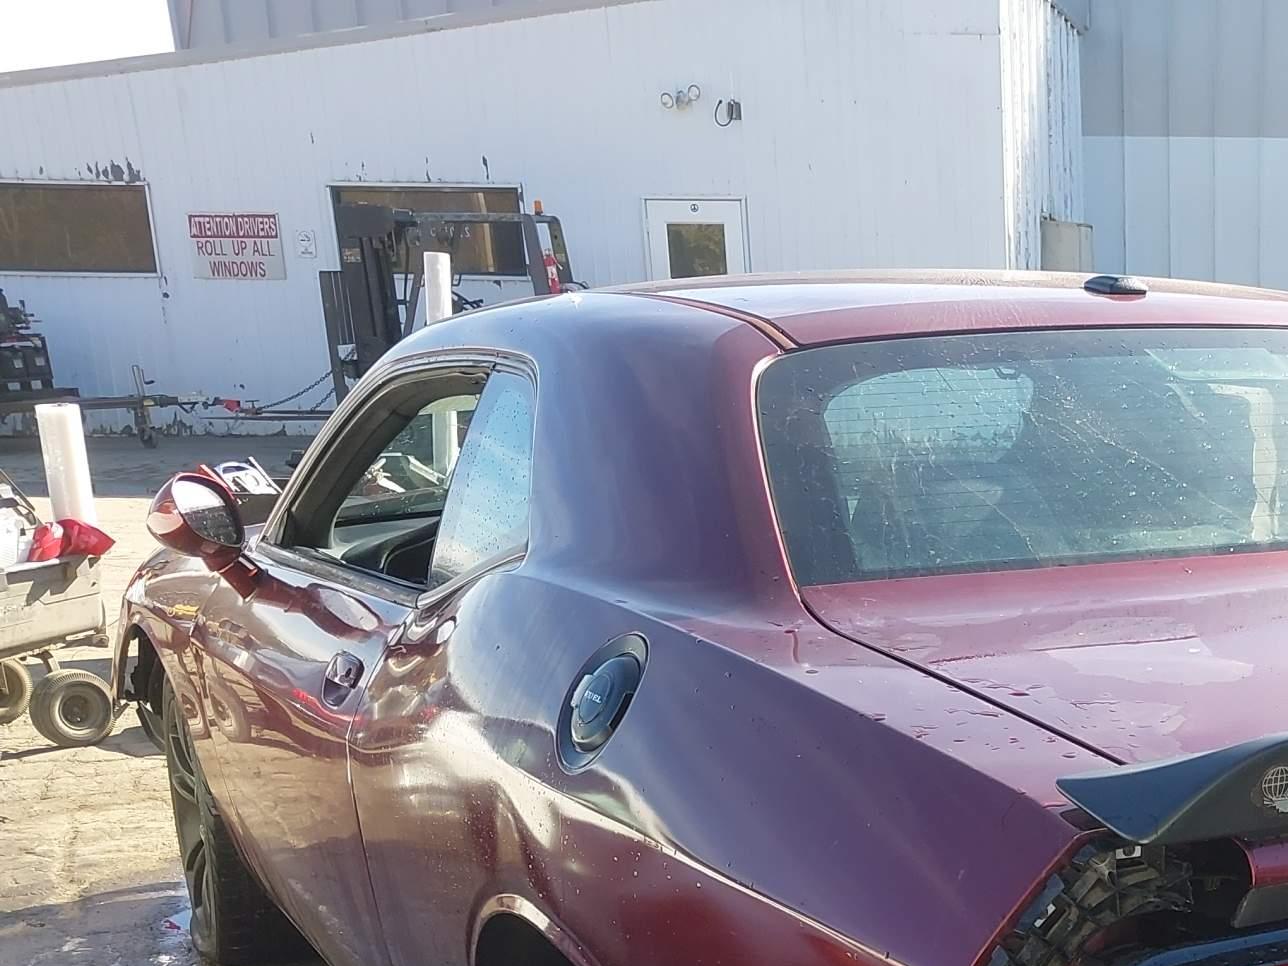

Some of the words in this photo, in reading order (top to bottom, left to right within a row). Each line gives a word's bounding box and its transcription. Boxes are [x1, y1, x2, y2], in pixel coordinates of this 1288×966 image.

[190, 216, 237, 237] ATTENTION
[239, 216, 277, 237] DRIVERS
[196, 240, 228, 256] ROLL
[231, 240, 248, 256] UP
[252, 240, 275, 256] ALL
[208, 261, 266, 277] WINDOWS
